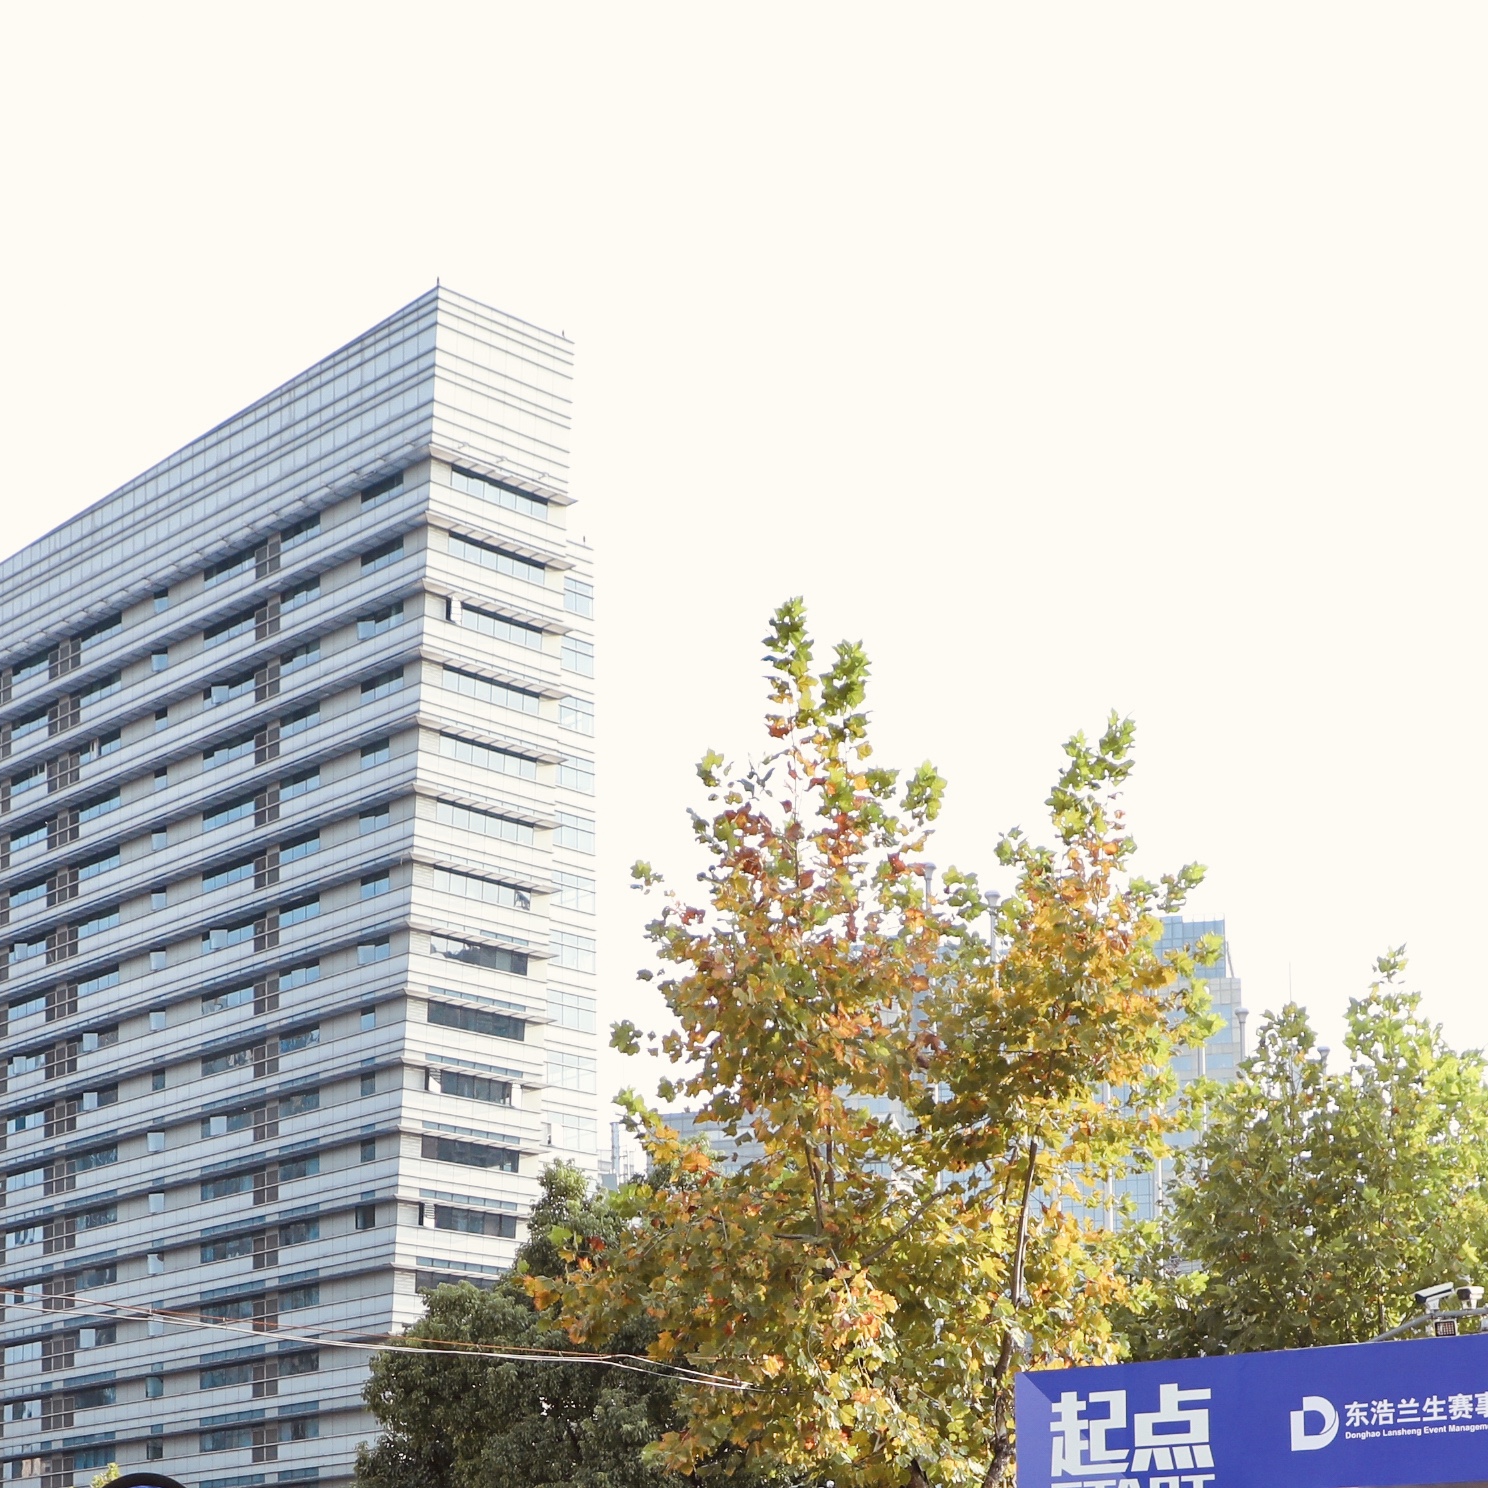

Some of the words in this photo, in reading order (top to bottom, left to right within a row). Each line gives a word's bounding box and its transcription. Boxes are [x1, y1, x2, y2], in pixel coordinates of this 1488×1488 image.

[1050, 1383, 1214, 1477] 起点
[1345, 1430, 1381, 1440] Donghao
[1383, 1427, 1422, 1437] Lansheng
[1424, 1424, 1447, 1434] Event
